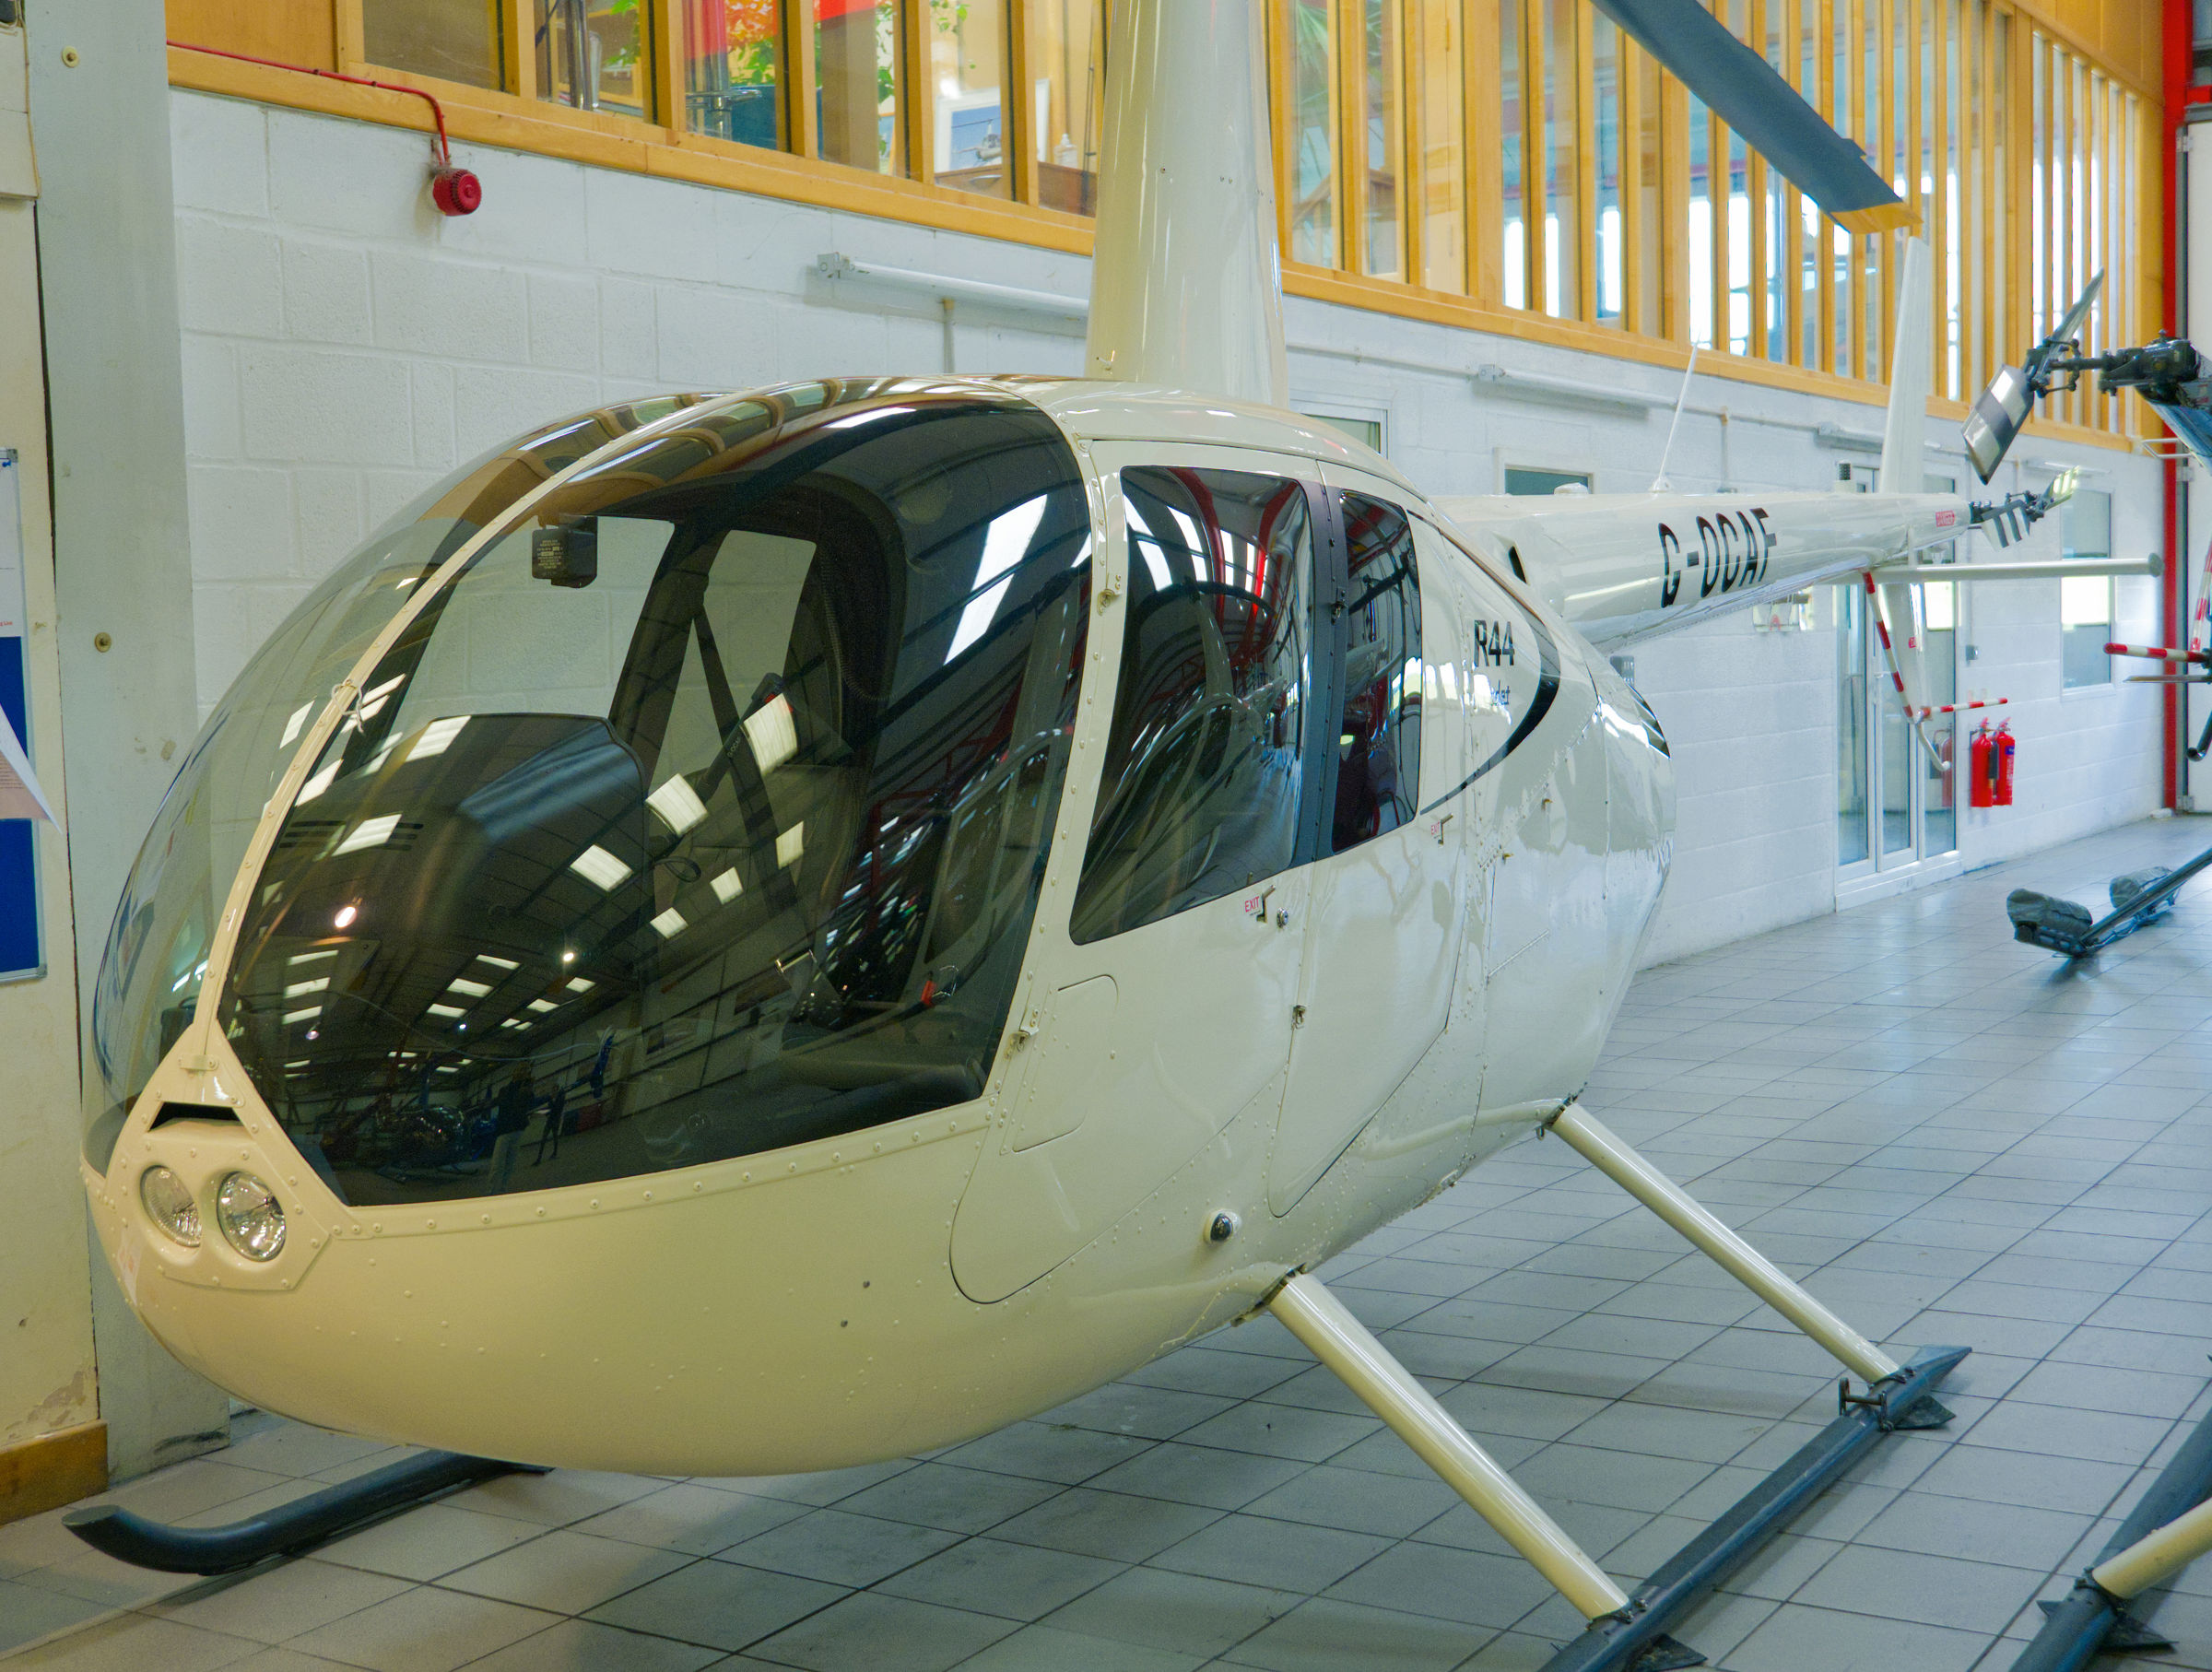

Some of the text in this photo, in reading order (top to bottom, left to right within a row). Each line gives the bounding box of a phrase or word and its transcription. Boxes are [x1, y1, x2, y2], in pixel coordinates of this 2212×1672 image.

[1474, 619, 1515, 667] R44
[1430, 821, 1441, 835] EXIT
[1244, 896, 1260, 913] EXIT
